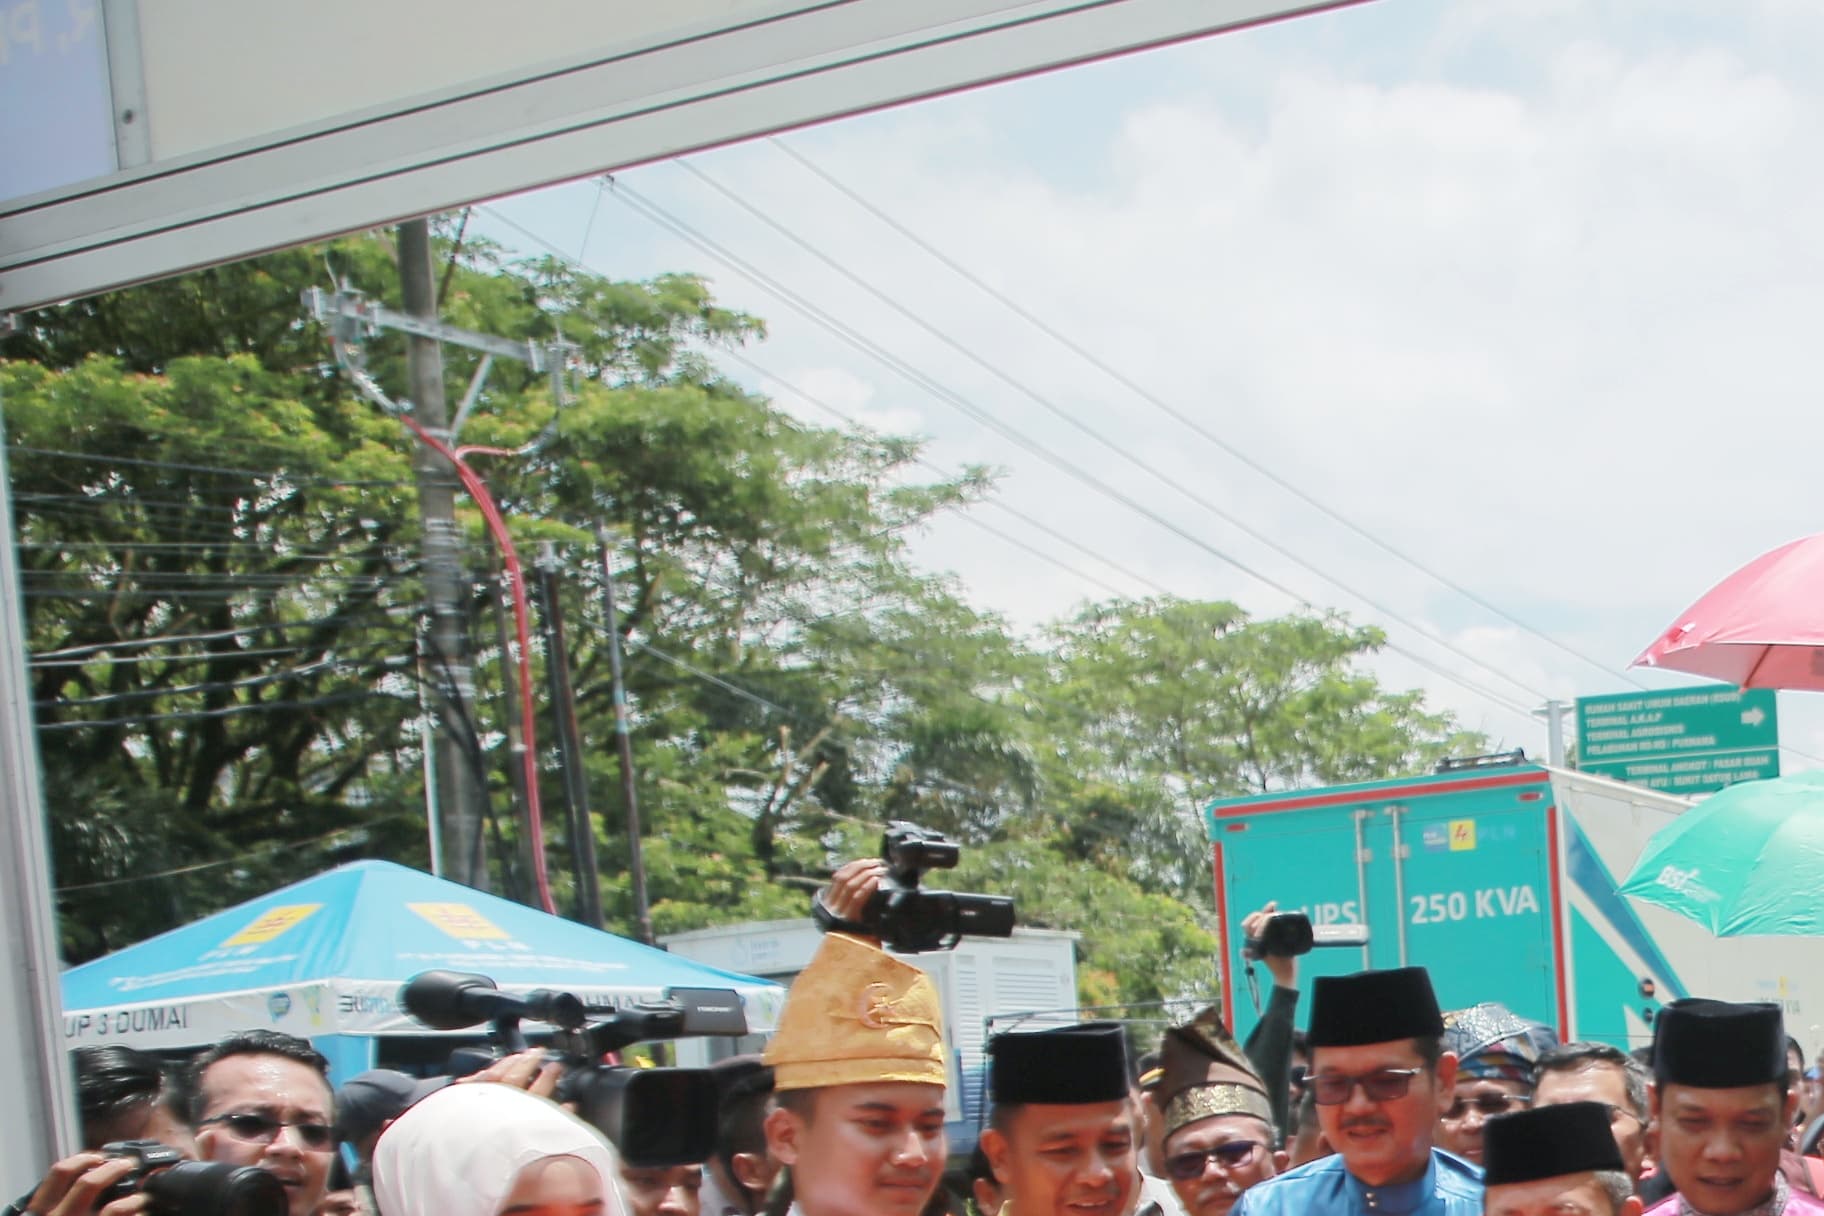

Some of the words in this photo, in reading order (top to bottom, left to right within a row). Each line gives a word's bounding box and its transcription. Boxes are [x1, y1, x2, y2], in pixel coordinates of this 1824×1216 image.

[1587, 716, 1629, 728] TERMINAL
[1586, 731, 1629, 742] TERMINAL
[1626, 764, 1669, 776] TERMINAL
[1411, 891, 1467, 924] 250
[1475, 885, 1540, 918] KVA
[115, 1007, 188, 1033] DUMAI
